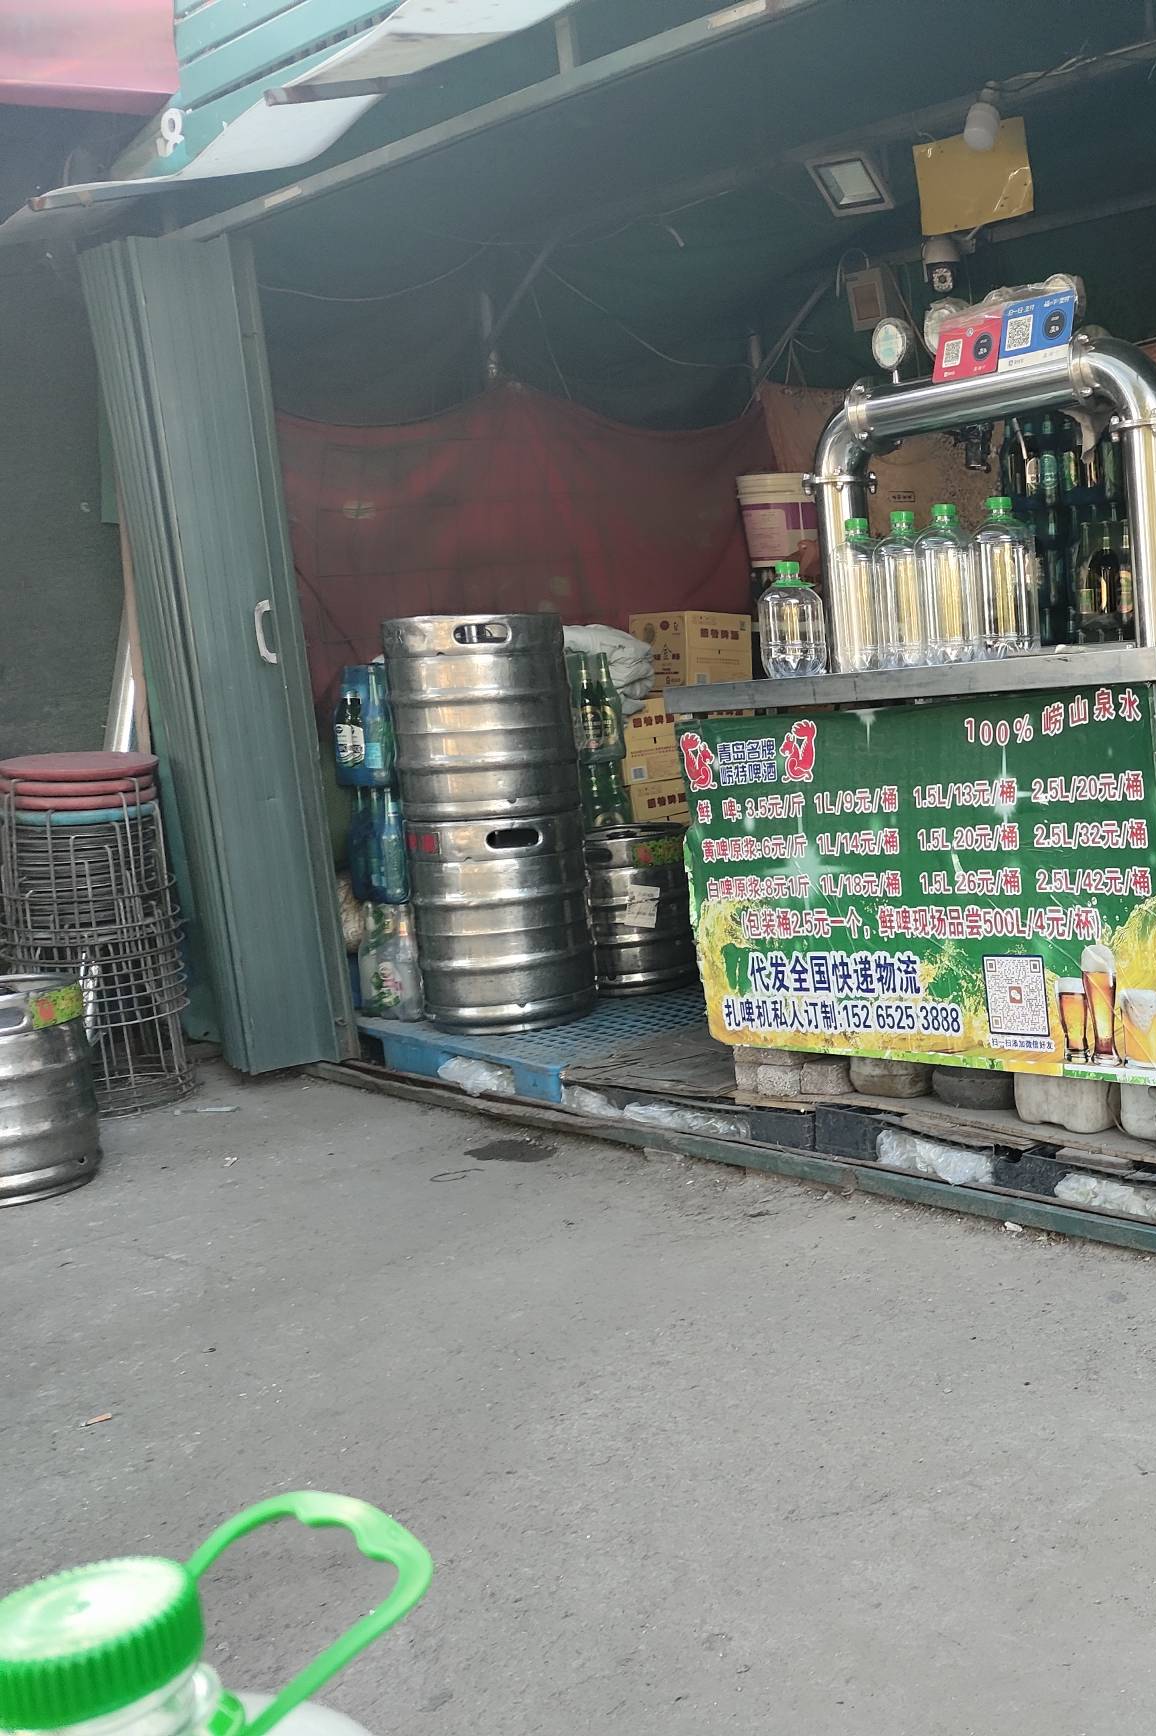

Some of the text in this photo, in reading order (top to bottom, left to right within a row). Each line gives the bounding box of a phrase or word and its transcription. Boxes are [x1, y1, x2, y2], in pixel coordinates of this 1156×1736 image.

[965, 688, 1142, 746] 100% 崂山泉水
[717, 738, 776, 763] 青岛名牌
[719, 762, 777, 785] 崂特啤酒
[814, 786, 899, 814] 1L/9元/桶
[816, 828, 900, 856] 1L/14元/桶
[820, 870, 902, 898] 1L/18元/桶
[750, 954, 920, 994] 代发全国快递物流
[876, 1004, 915, 1029] 6525
[920, 1006, 960, 1033] 3888
[991, 1037, 1054, 1050] 扫一扫添加微信好友
